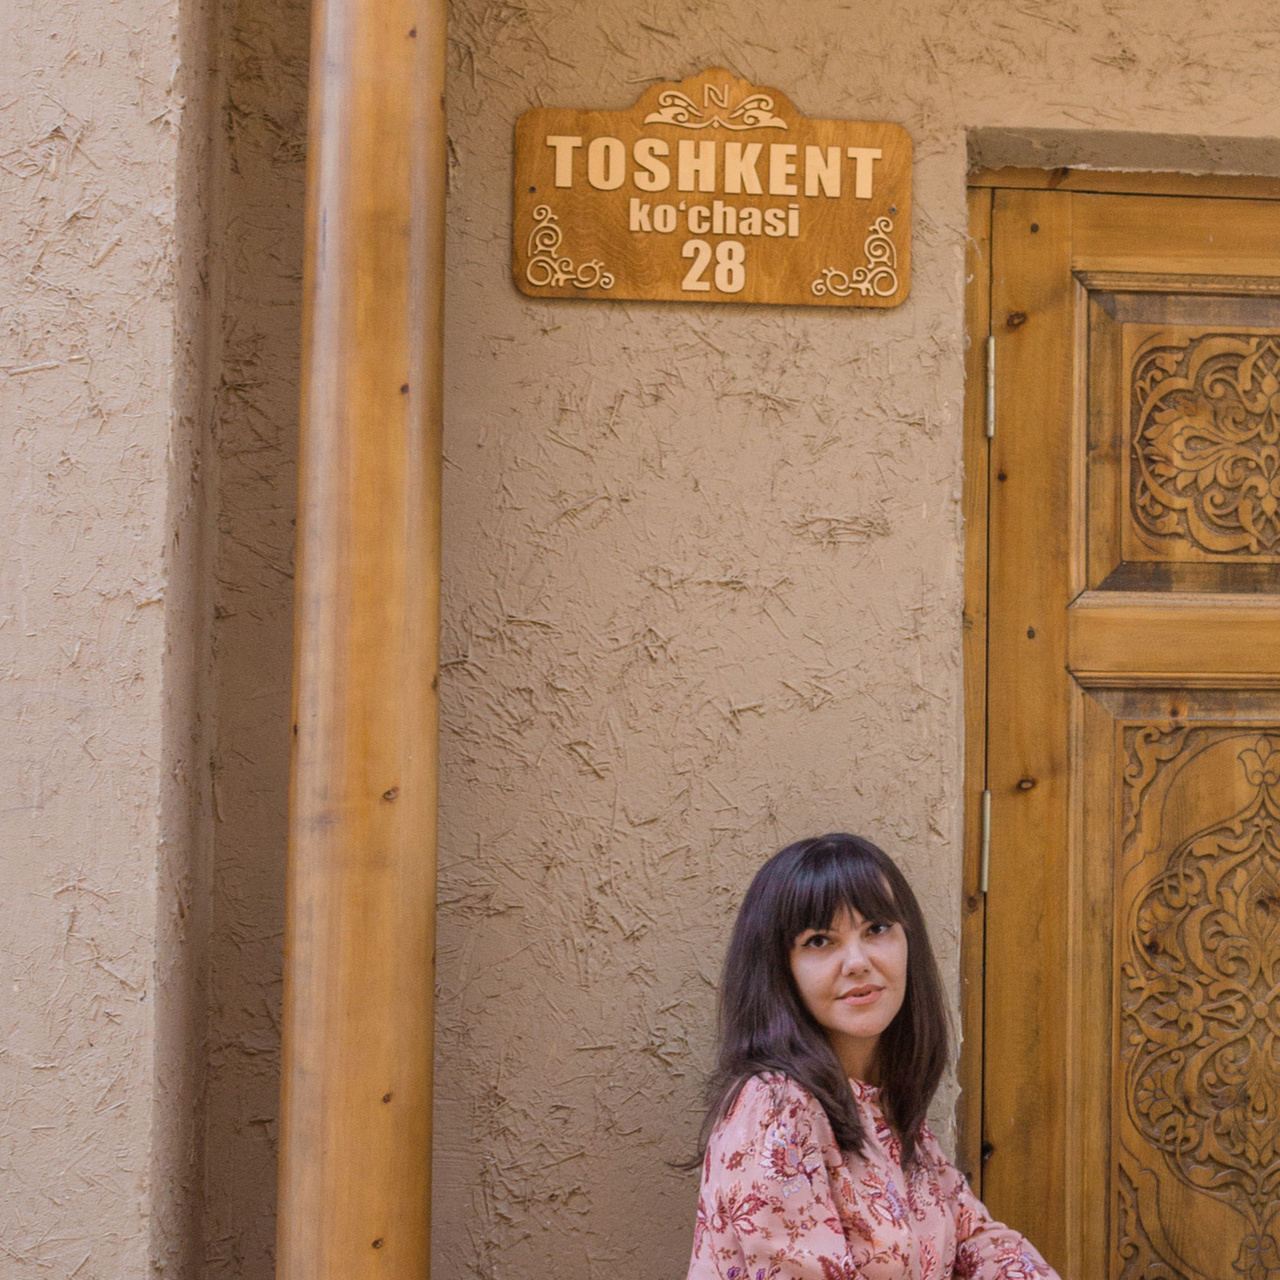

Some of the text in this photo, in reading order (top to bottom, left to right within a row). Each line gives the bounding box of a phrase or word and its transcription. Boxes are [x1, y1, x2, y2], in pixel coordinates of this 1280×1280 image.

[546, 135, 882, 199] TOSHKENT
[629, 198, 799, 237] ko‘chasi
[681, 239, 745, 293] 28
